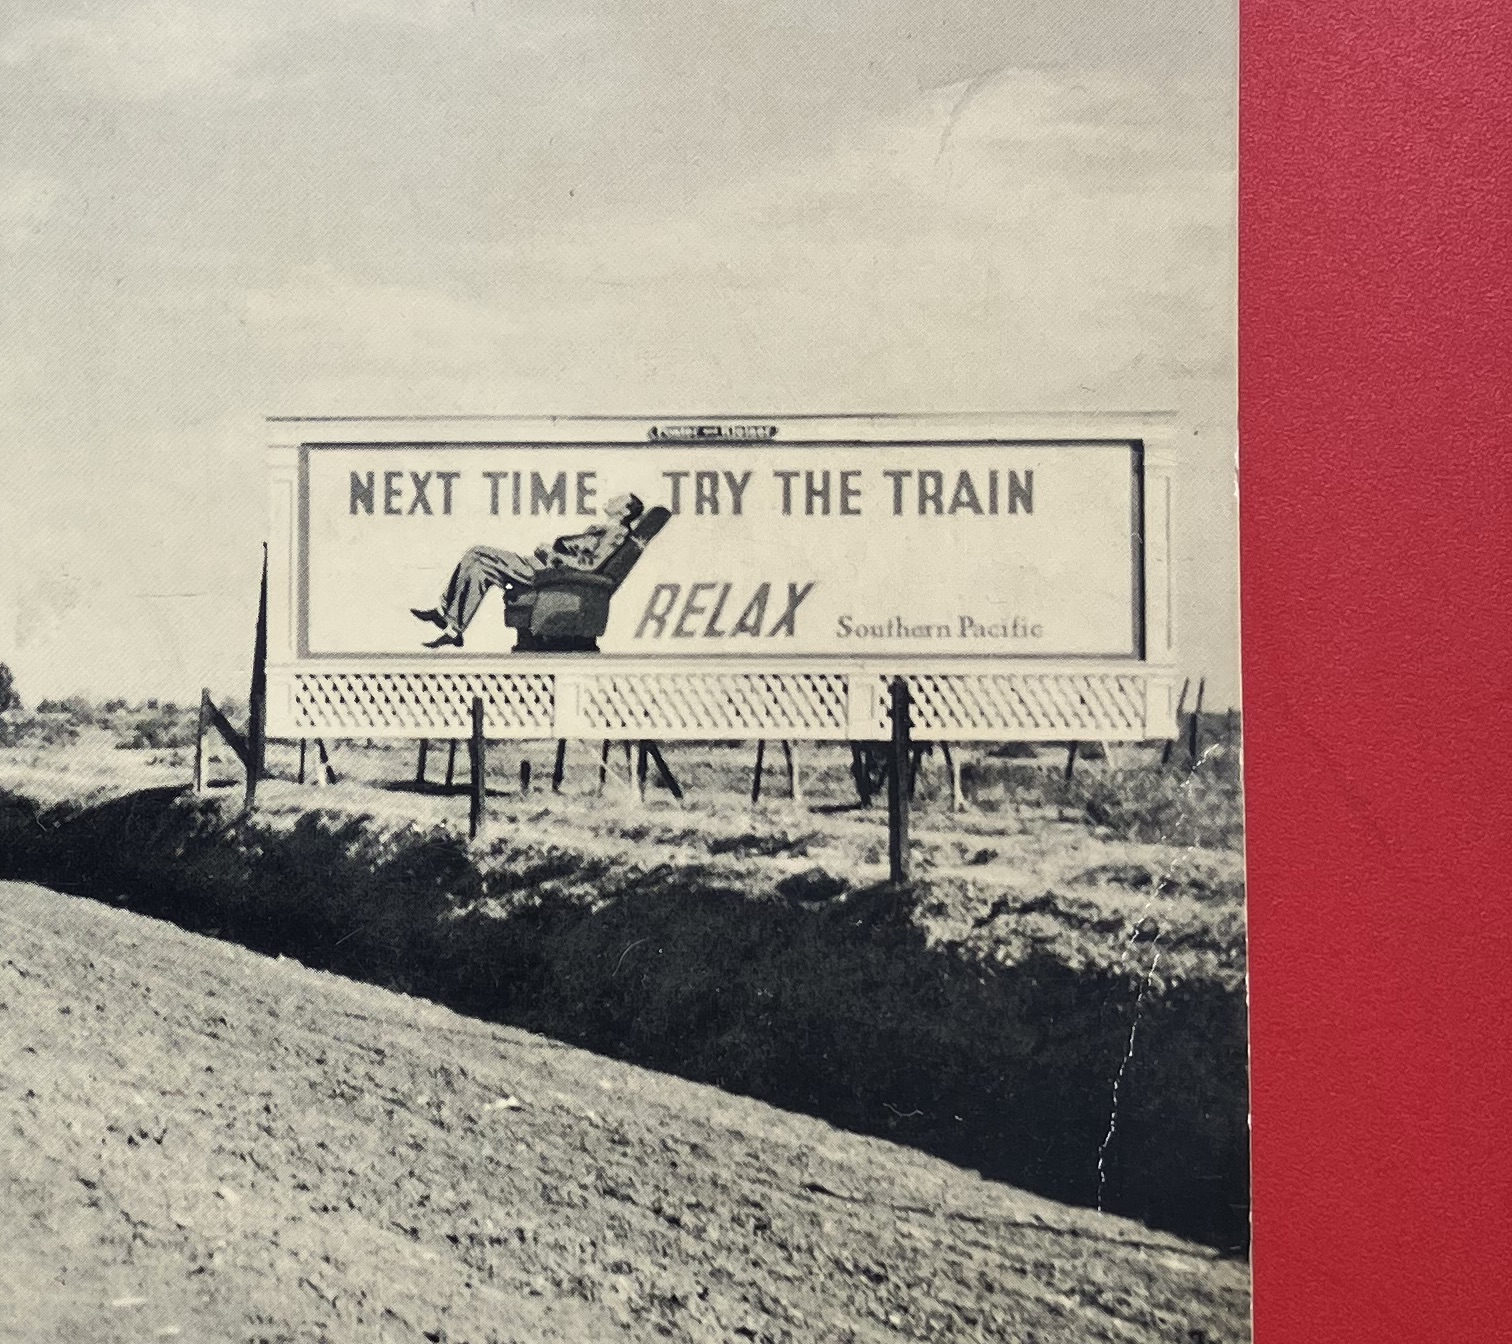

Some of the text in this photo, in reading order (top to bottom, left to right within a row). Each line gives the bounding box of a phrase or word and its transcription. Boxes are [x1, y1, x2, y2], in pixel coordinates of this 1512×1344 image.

[349, 468, 1035, 516] NEXT TIME TRY THE TRAIN
[633, 580, 817, 640] RELAX
[835, 614, 1044, 640] Southern Pacific
